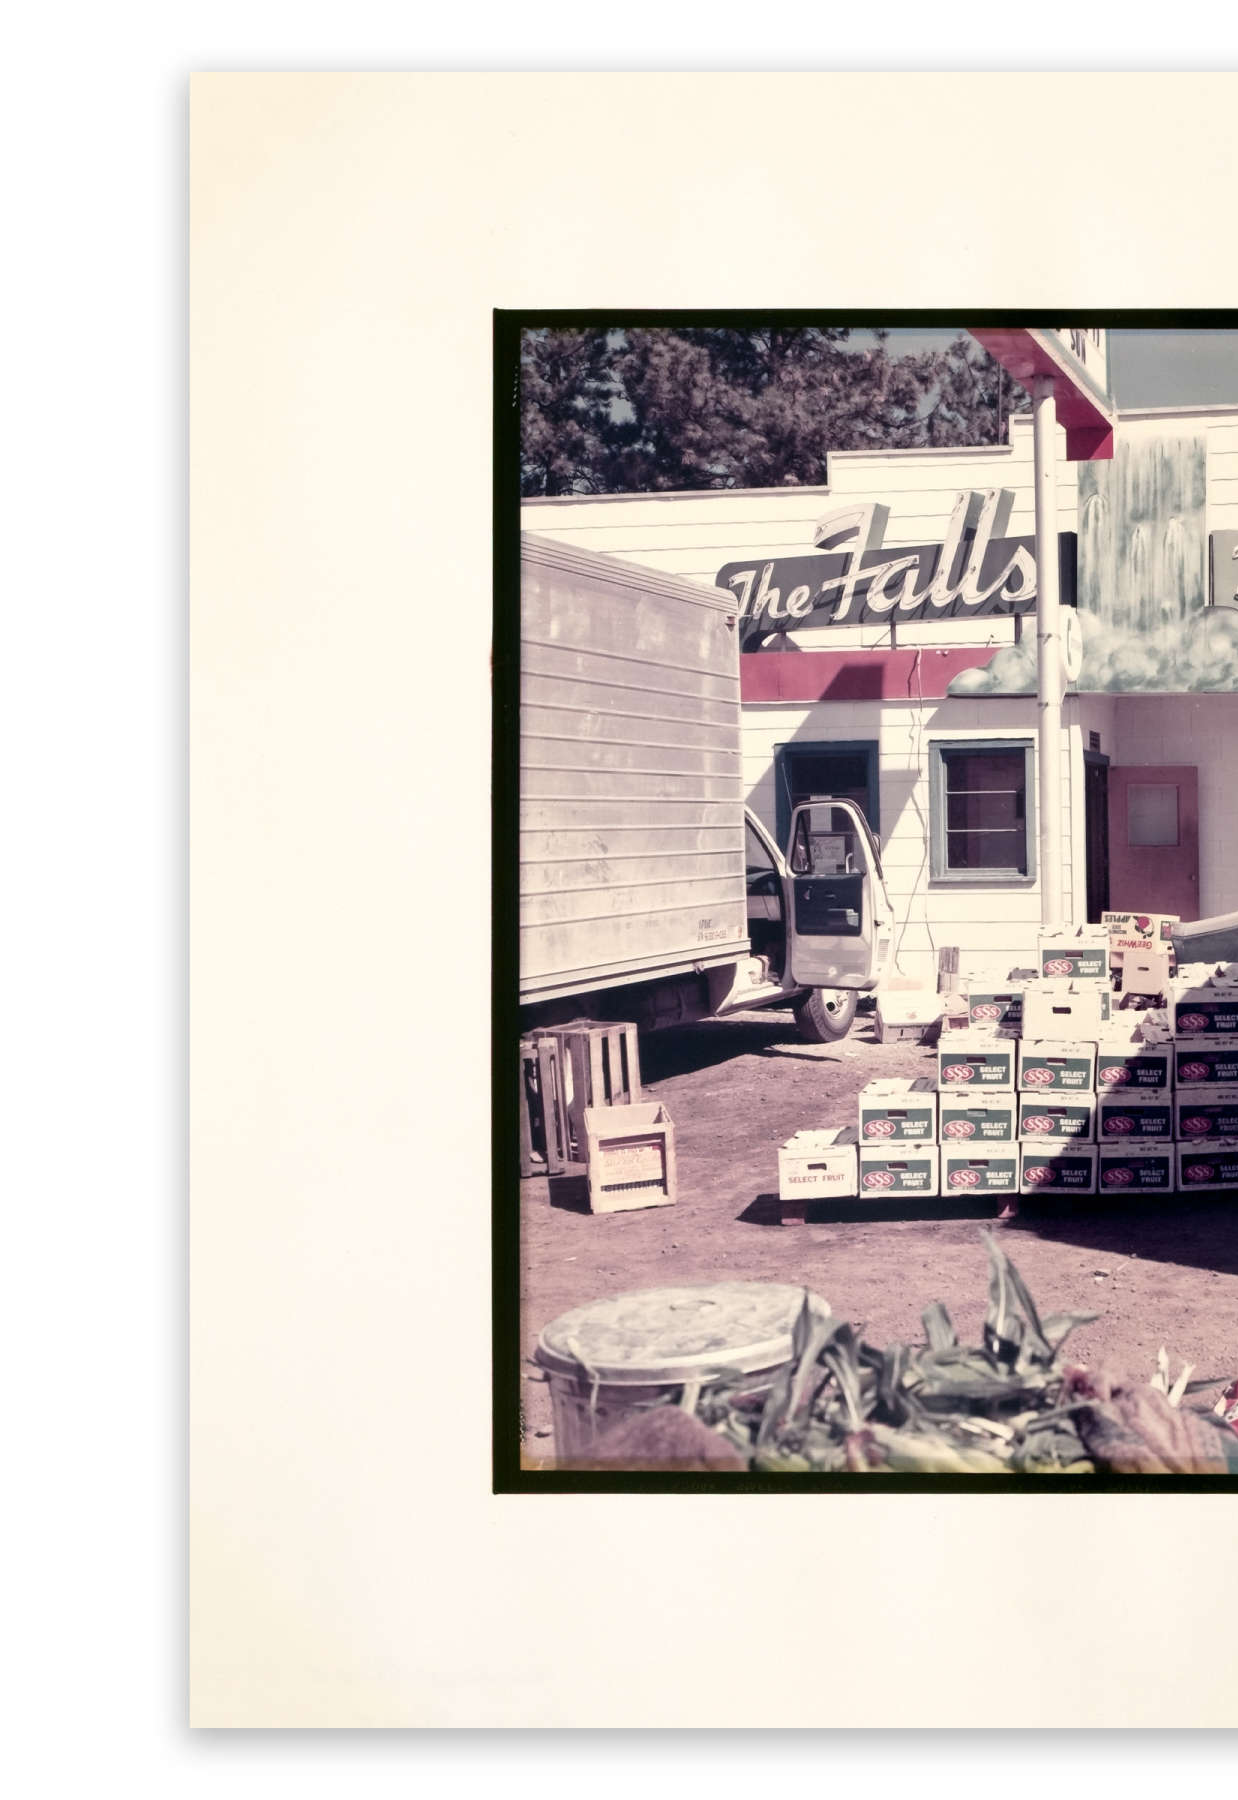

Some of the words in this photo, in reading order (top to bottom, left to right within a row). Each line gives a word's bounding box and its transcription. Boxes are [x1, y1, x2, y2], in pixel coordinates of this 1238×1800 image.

[728, 562, 814, 620] The
[813, 488, 1037, 620] Falls
[1216, 1021, 1237, 1029] FRUIT
[1062, 1077, 1083, 1085] FRUIT
[1061, 1125, 1082, 1133] FRUIT
[822, 1174, 845, 1182] FRUIT
